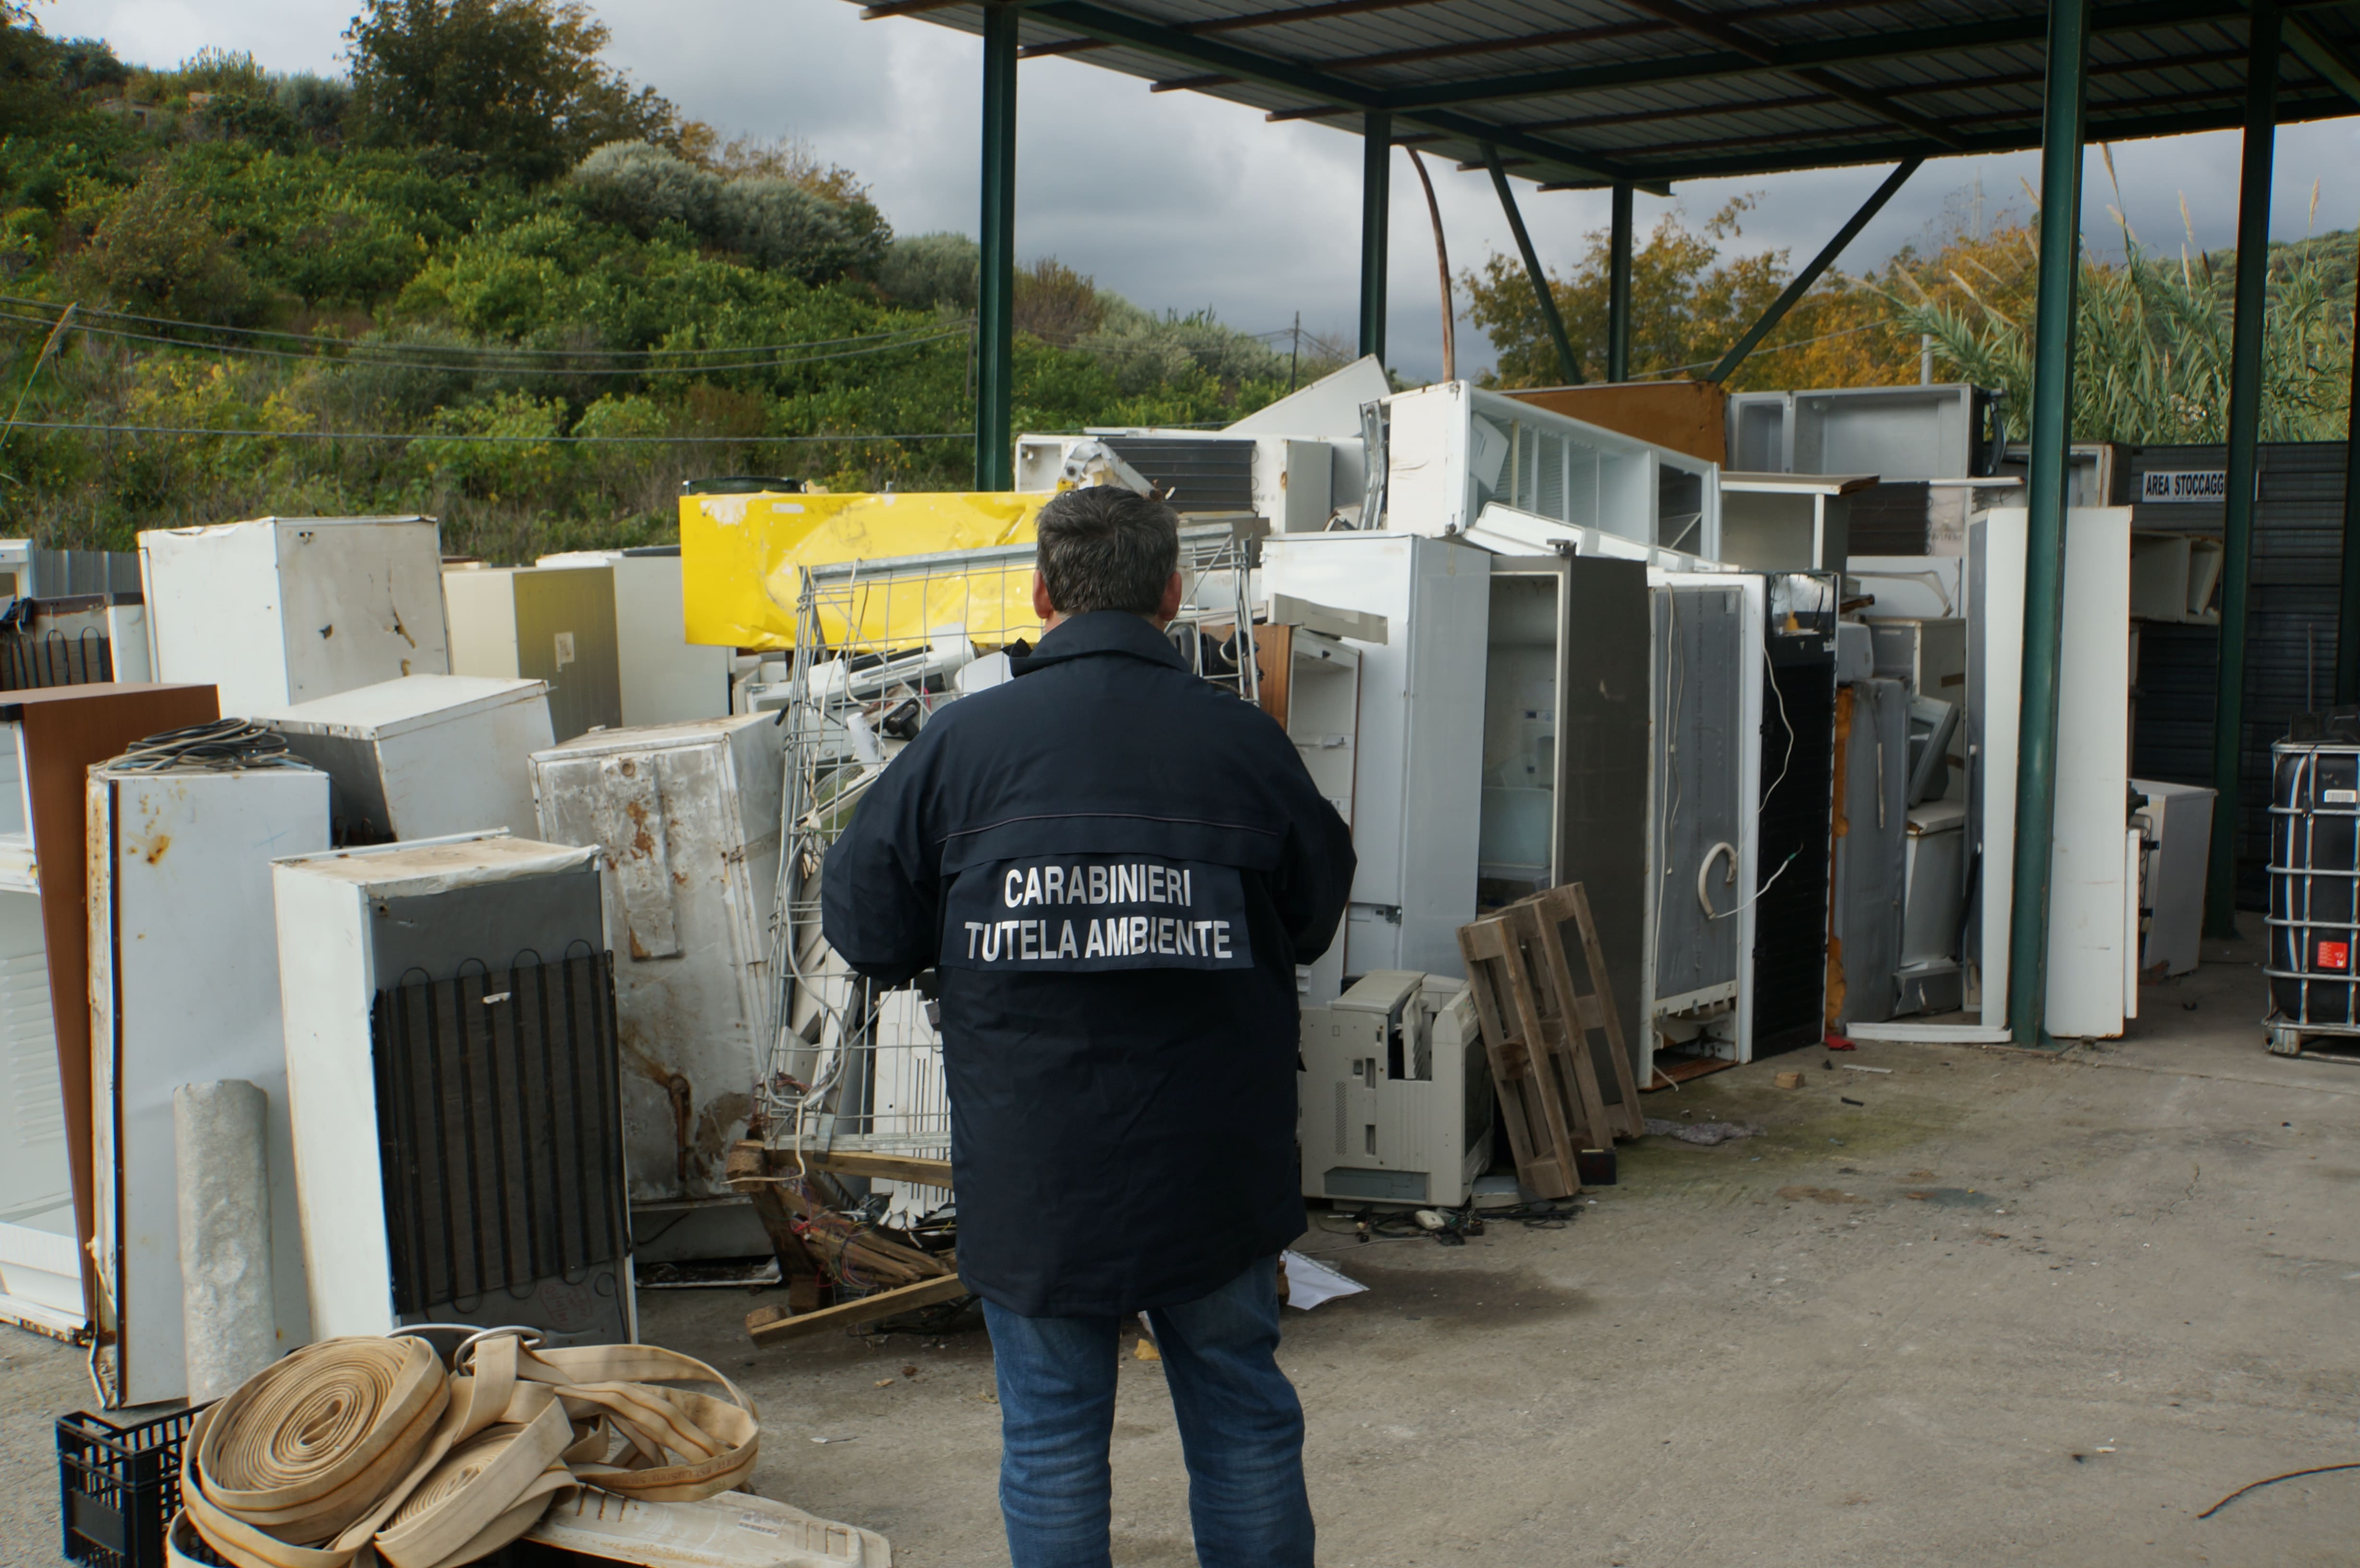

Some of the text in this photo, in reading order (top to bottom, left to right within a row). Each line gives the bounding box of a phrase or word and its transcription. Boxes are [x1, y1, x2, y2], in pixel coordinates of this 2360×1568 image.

[2146, 474, 2169, 496] AREA
[1005, 864, 1192, 908] CARABINIERI
[964, 916, 1232, 962] TUTELA AMBIENTE
